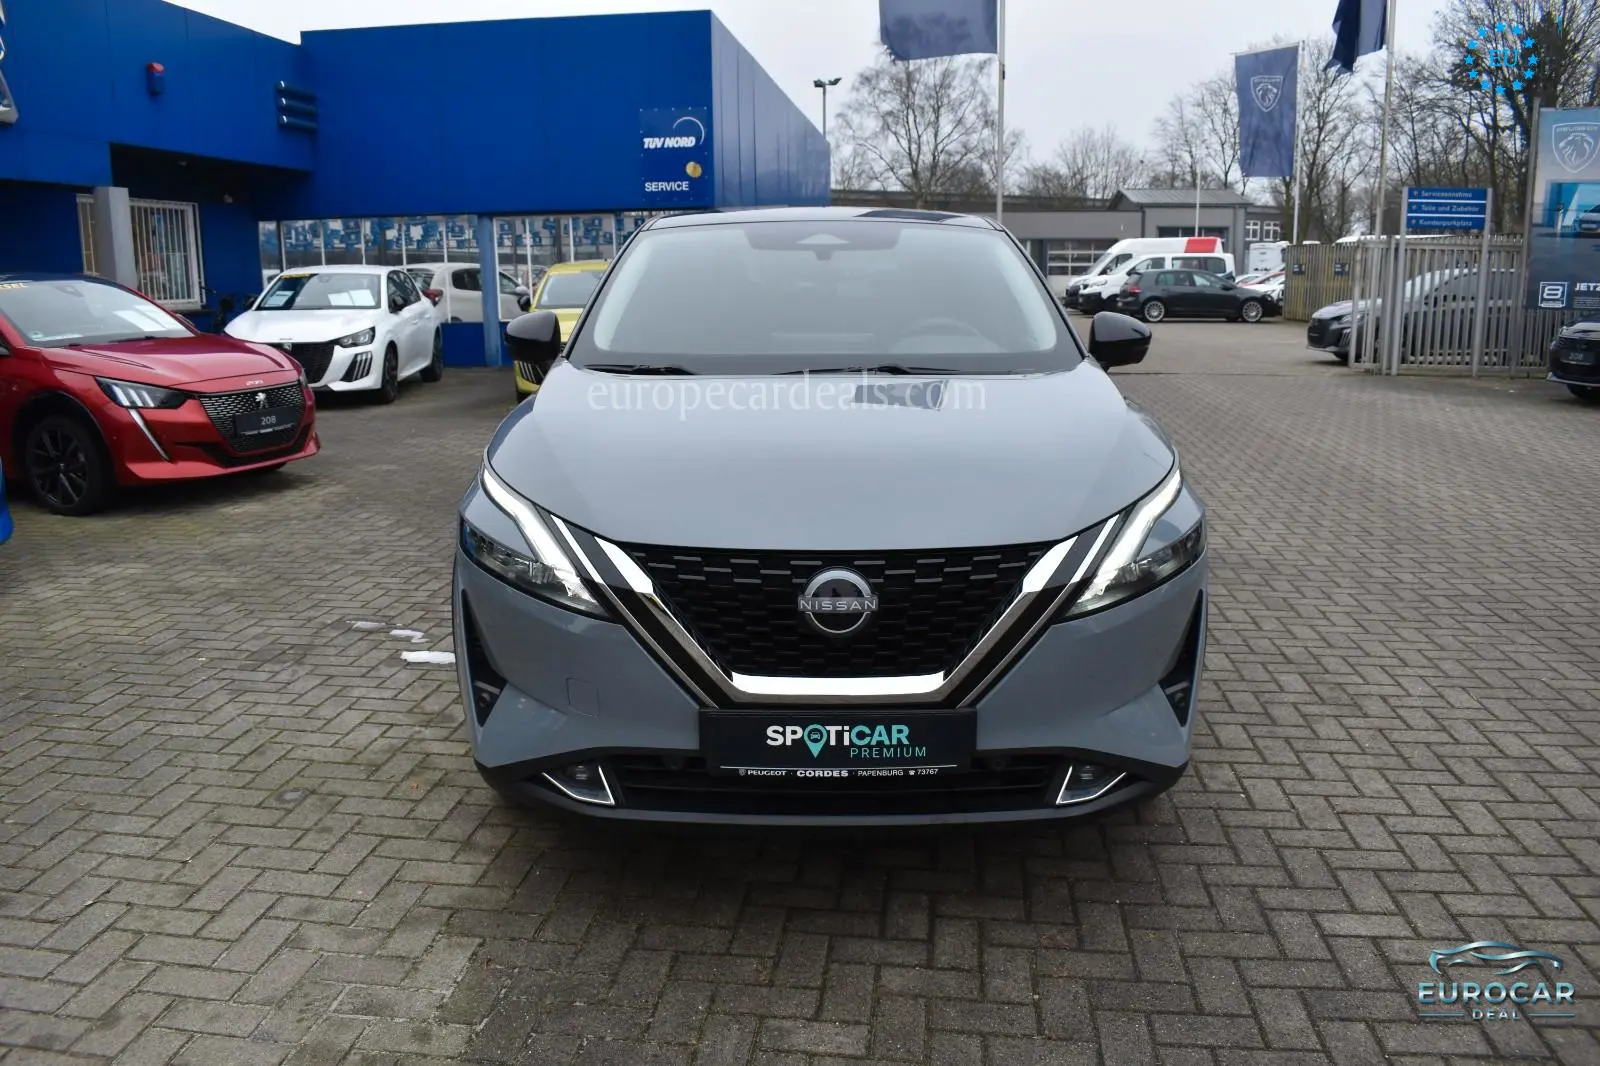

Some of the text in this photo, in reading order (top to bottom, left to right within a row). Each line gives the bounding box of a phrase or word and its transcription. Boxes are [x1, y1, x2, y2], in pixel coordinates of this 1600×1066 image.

[664, 136, 696, 148] NORD
[644, 181, 689, 192] SERVICE
[261, 415, 277, 425] 208
[800, 599, 876, 611] NISSAN
[850, 747, 927, 758] PREMIUM
[796, 769, 849, 777] CORDES
[857, 769, 904, 777] PAPENBURG
